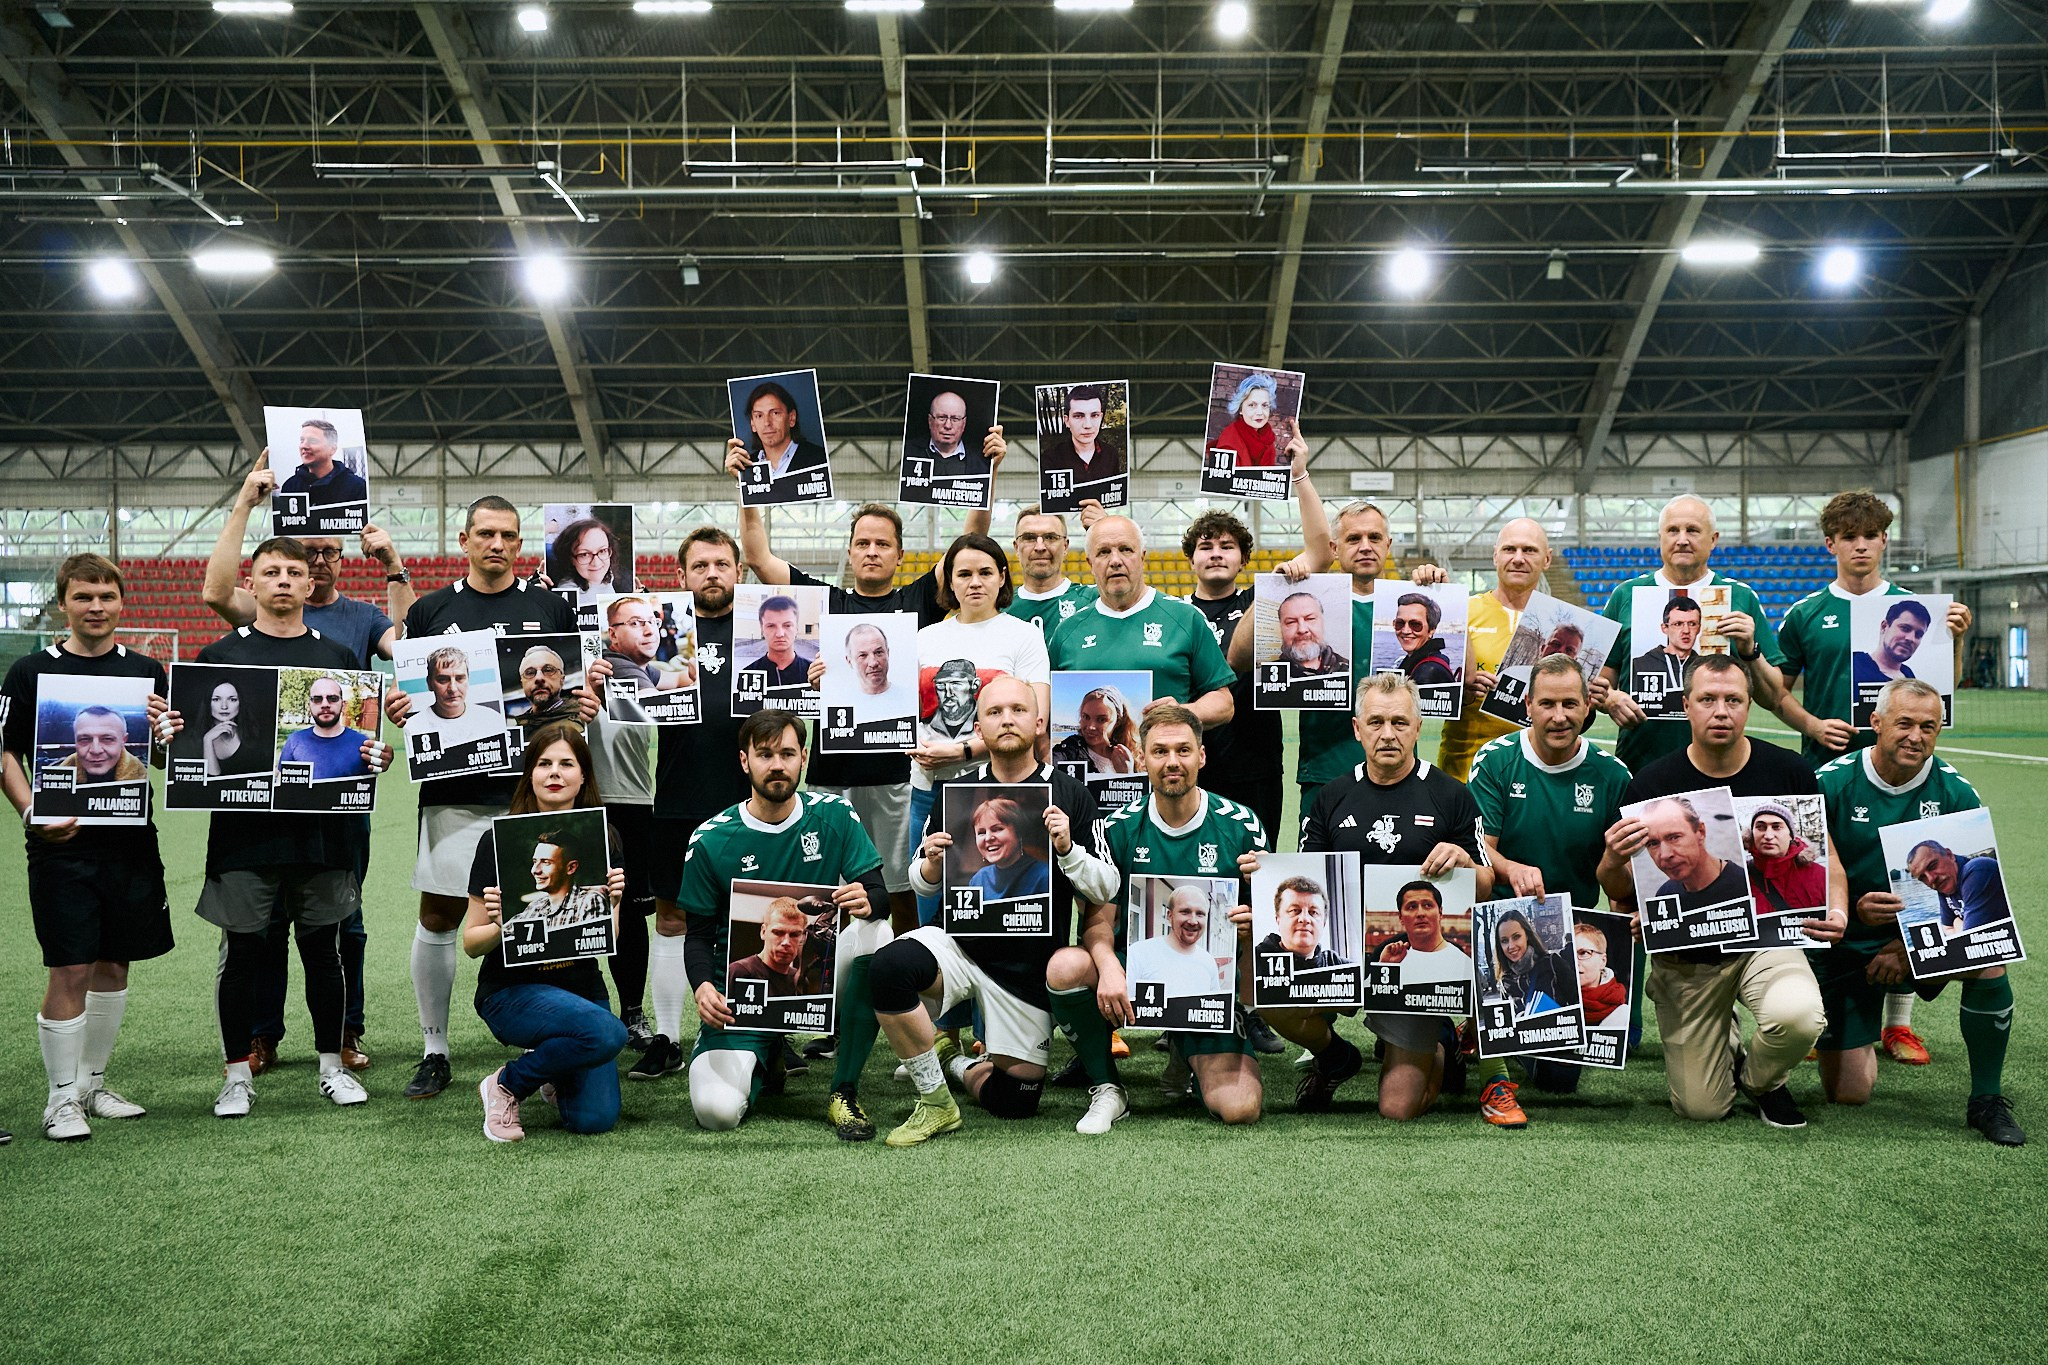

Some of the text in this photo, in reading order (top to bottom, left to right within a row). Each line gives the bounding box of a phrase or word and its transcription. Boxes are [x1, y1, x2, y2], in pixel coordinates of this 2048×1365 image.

[1215, 453, 1229, 469] 10
[752, 466, 762, 482] 3
[914, 462, 922, 476] 4
[1209, 468, 1231, 478] years
[906, 476, 929, 487] years
[1051, 474, 1065, 488] 15
[1232, 478, 1285, 493] KASTSIUHOVA
[747, 484, 771, 495] years
[797, 481, 827, 495] KARNEI
[1047, 488, 1070, 499] years
[932, 488, 983, 502] MANTSEVICH
[1101, 491, 1122, 504] LOSIK
[289, 498, 298, 514] 6
[345, 509, 362, 517] Pavel
[282, 516, 306, 527] years
[320, 518, 362, 530] MAZHEIKA
[1270, 666, 1278, 682] 3
[742, 674, 761, 692] 1,5
[1263, 682, 1286, 693] years
[1323, 680, 1345, 688] Yauhen
[1506, 679, 1517, 694] 4
[1643, 676, 1658, 692] 13
[739, 691, 762, 702] years
[1303, 689, 1346, 701] GLUSHKOU
[1434, 689, 1450, 699] Iryna
[1495, 689, 1518, 706] years
[1638, 692, 1662, 702] years
[645, 704, 695, 717] CHABOTSKA
[837, 709, 846, 727] 3
[897, 721, 911, 730] Ales
[830, 728, 854, 739] years
[864, 731, 913, 743] MARCHANKA
[421, 735, 431, 751] 8
[416, 751, 441, 764] years
[468, 750, 502, 765] SATSUK
[247, 780, 268, 789] Palina
[1109, 780, 1143, 790] Katsiaryna
[120, 788, 139, 796] Daniil
[221, 790, 269, 802] PITKEVICH
[340, 793, 370, 804] ILYASH
[1100, 791, 1142, 802] ANDREEVA
[88, 798, 140, 811] PALIANSKI
[955, 891, 973, 908] 12
[953, 909, 979, 921] years
[1658, 901, 1668, 918] 4
[1003, 914, 1042, 926] CHEKINA
[1651, 918, 1679, 933] years
[524, 923, 534, 941] 7
[582, 925, 605, 936] Andrei
[1689, 918, 1749, 938] SABALEUSKI
[575, 936, 606, 950] FAMIN
[1920, 927, 1934, 947] 6
[517, 943, 545, 956] years
[1918, 946, 1947, 962] years
[1965, 939, 2016, 959] IHNATSUK
[1267, 957, 1285, 975] 14
[1263, 976, 1290, 988] years
[1331, 973, 1354, 982] Andrei
[1381, 967, 1389, 984] 3
[745, 985, 755, 1002] 4
[1145, 985, 1155, 1004] 4
[1289, 984, 1354, 997] ALIAKSANDRAU
[1372, 984, 1398, 995] years
[1435, 985, 1464, 996] Dzmitryi
[806, 1003, 826, 1012] Pavel
[1200, 998, 1224, 1009] Yauhen
[1405, 994, 1463, 1008] SEMCHANKA
[736, 1003, 763, 1015] years
[1136, 1006, 1163, 1018] years
[784, 1012, 825, 1025] PADABED
[1188, 1009, 1224, 1023] MERKIS
[1494, 1007, 1504, 1027] 5
[1557, 1015, 1576, 1025] Alena
[1488, 1027, 1514, 1041] years
[1518, 1026, 1579, 1044] TSIMASHCHUK
[1592, 1033, 1617, 1045] Maryna
